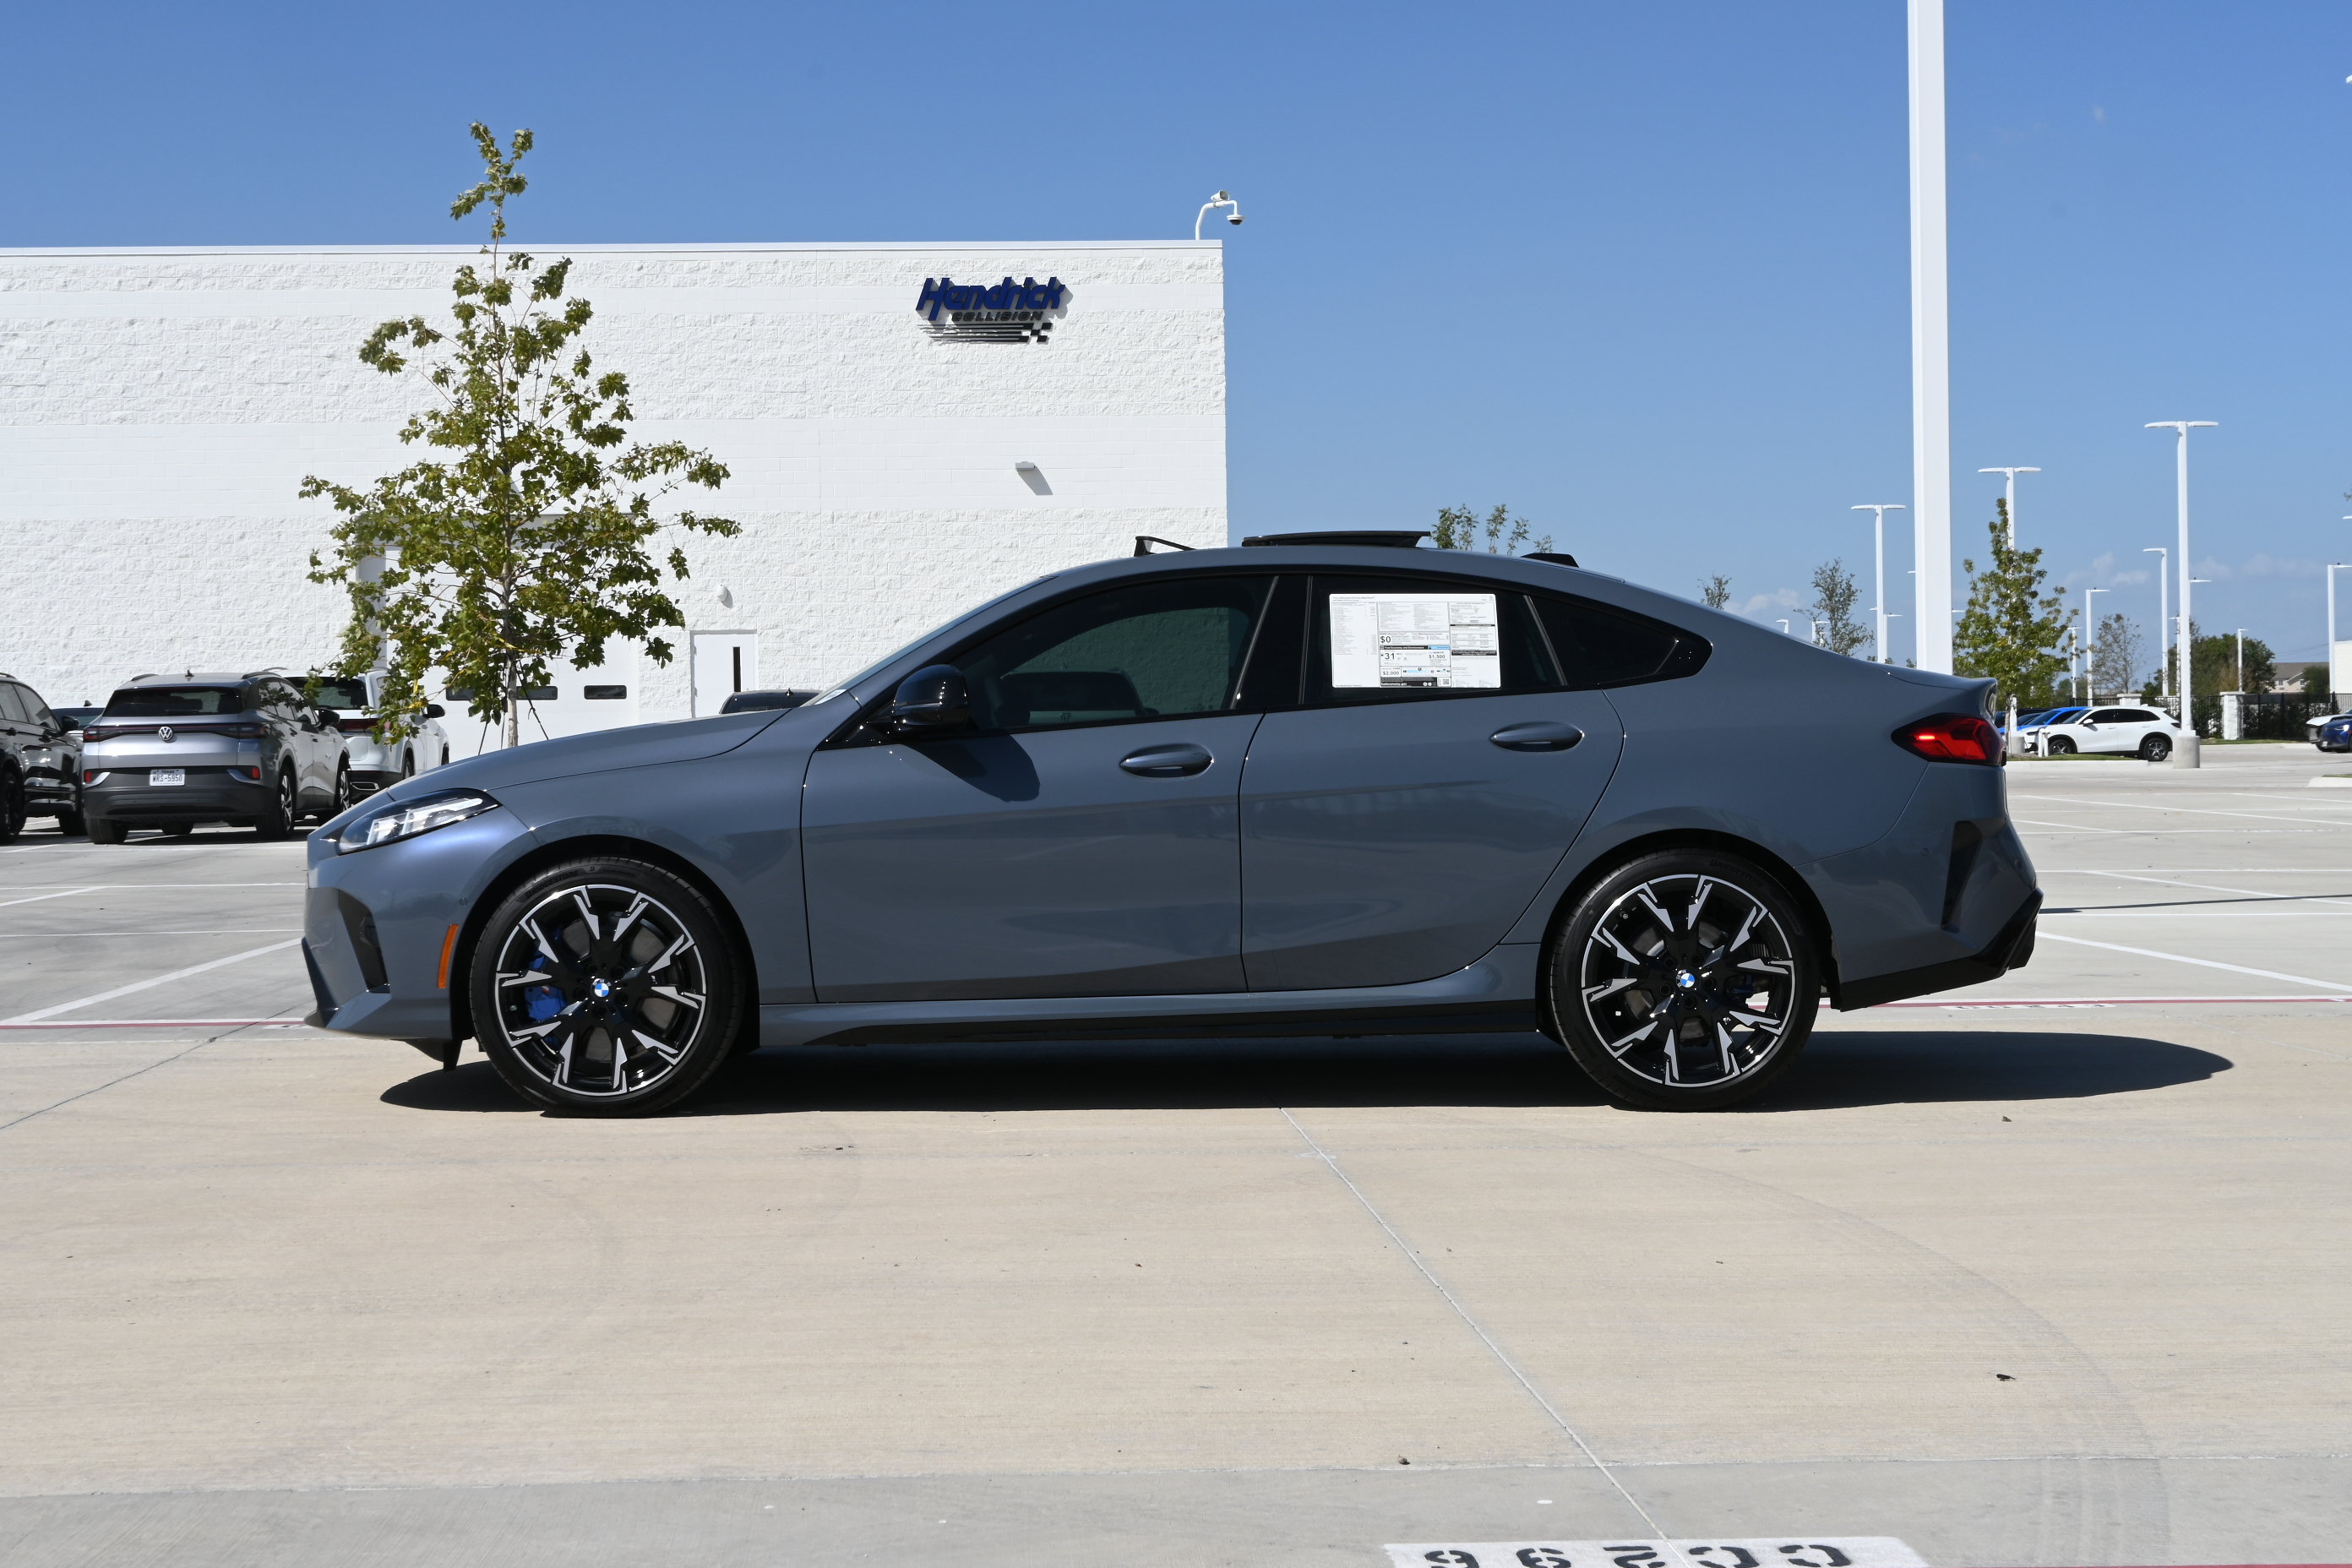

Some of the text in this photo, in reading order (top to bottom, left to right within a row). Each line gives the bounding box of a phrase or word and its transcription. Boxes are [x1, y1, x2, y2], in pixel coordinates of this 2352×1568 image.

[915, 276, 1066, 321] Hendrick
[951, 311, 1044, 322] COLLISION
[1380, 635, 1391, 644] $0
